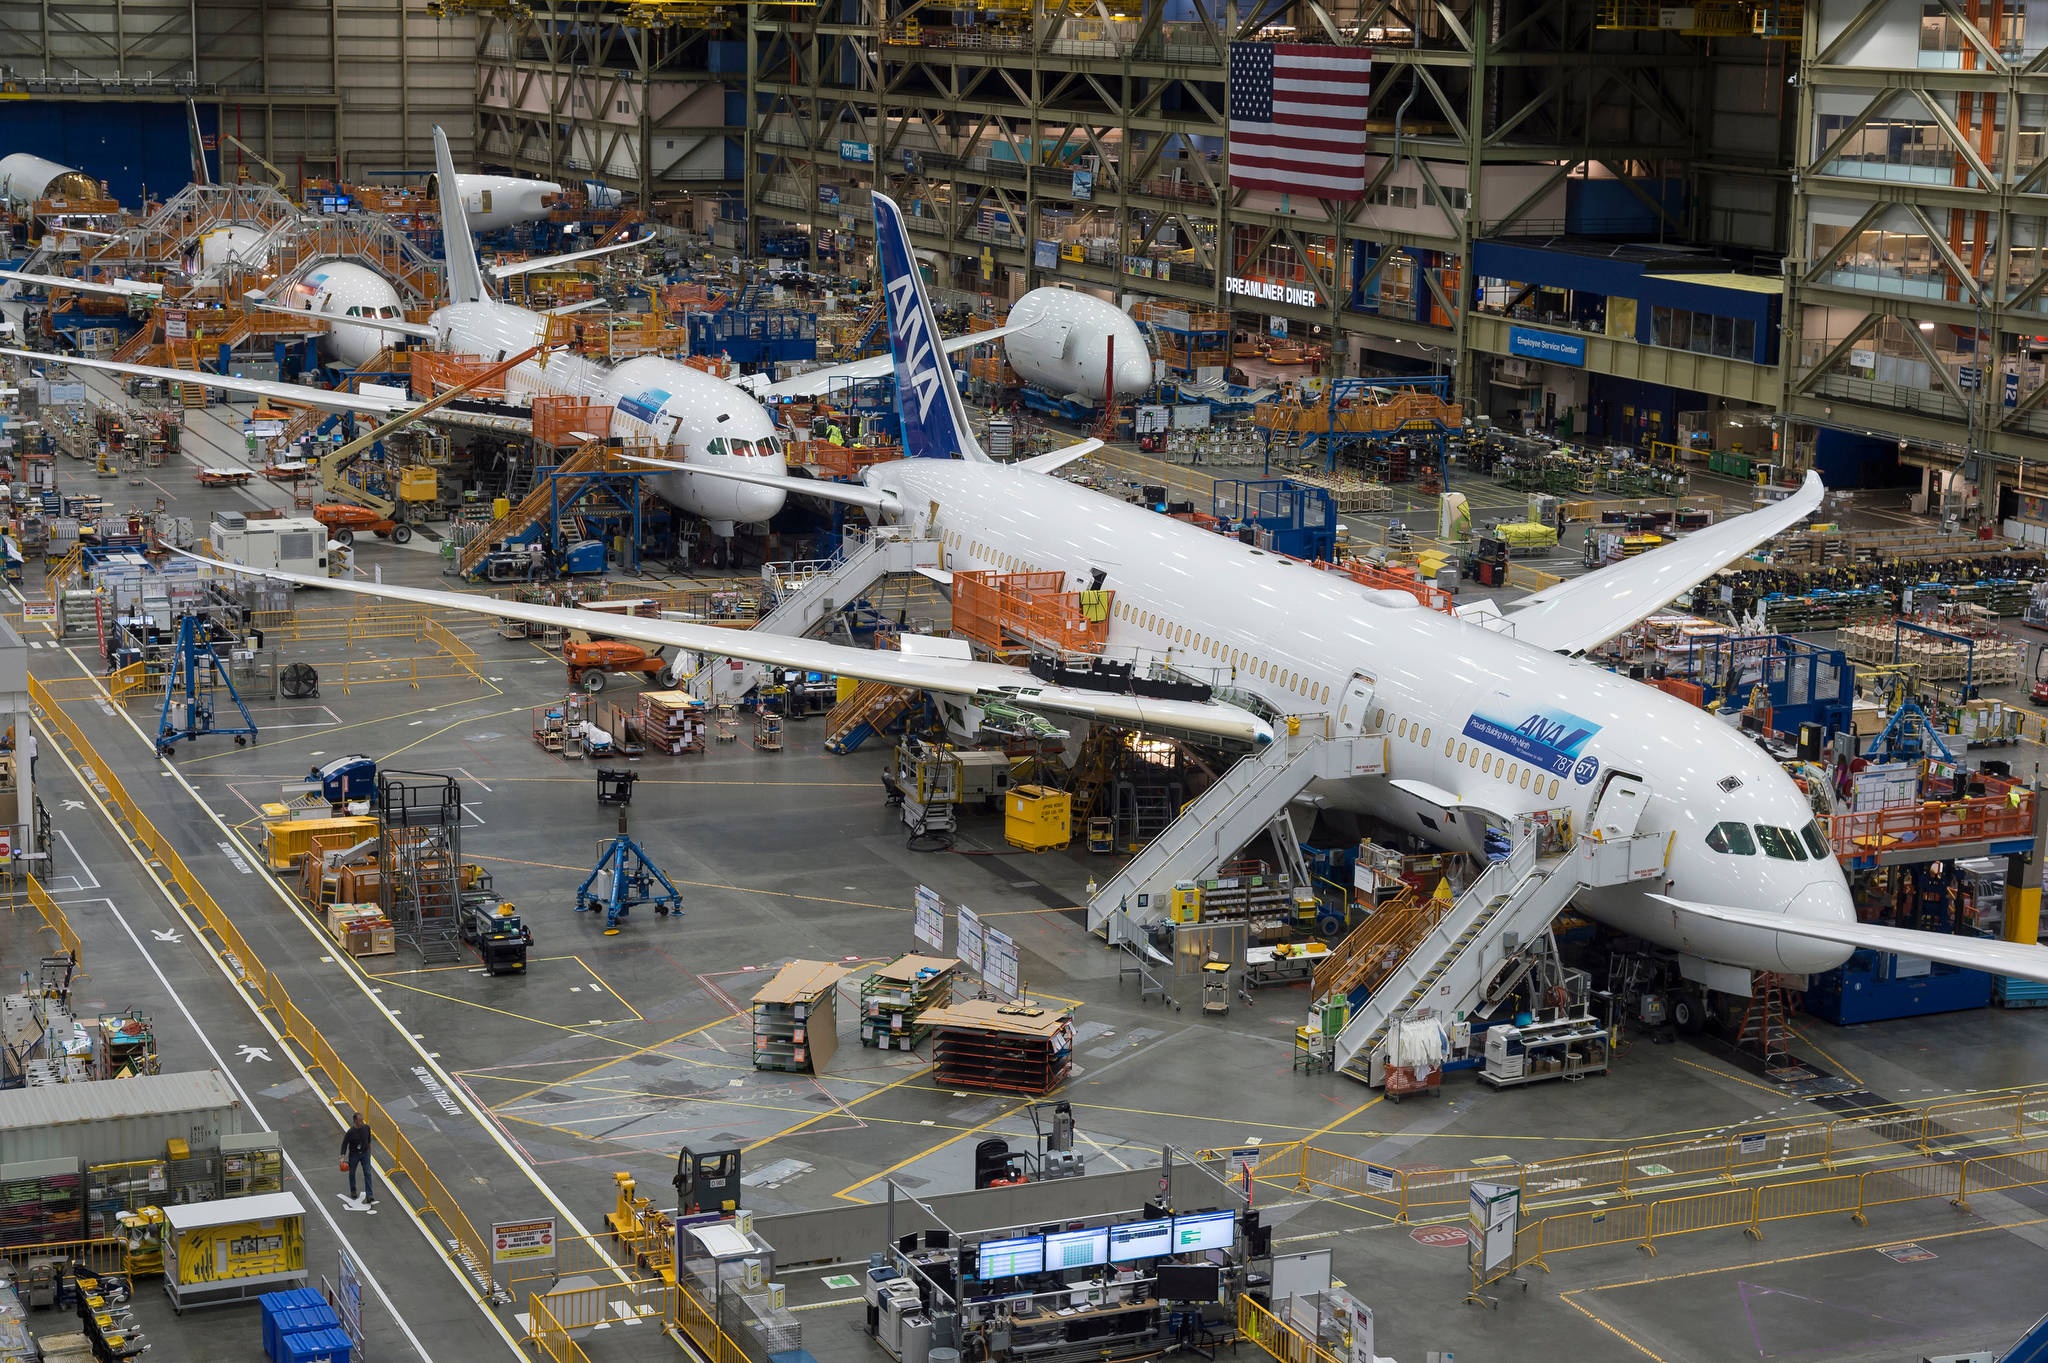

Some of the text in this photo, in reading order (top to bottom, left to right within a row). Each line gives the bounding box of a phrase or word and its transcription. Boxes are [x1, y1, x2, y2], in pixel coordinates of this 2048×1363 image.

[842, 143, 853, 157] 787
[1225, 276, 1315, 307] DREAMLINER DINER
[887, 273, 940, 425] ANA
[1517, 336, 1578, 354] Employee Service Center
[1470, 719, 1486, 732] Proudly
[1485, 725, 1502, 739] Building
[1514, 714, 1566, 746] ANA
[1552, 754, 1575, 772] 787
[1576, 762, 1596, 777] 571
[1421, 1230, 1467, 1243] STOP
